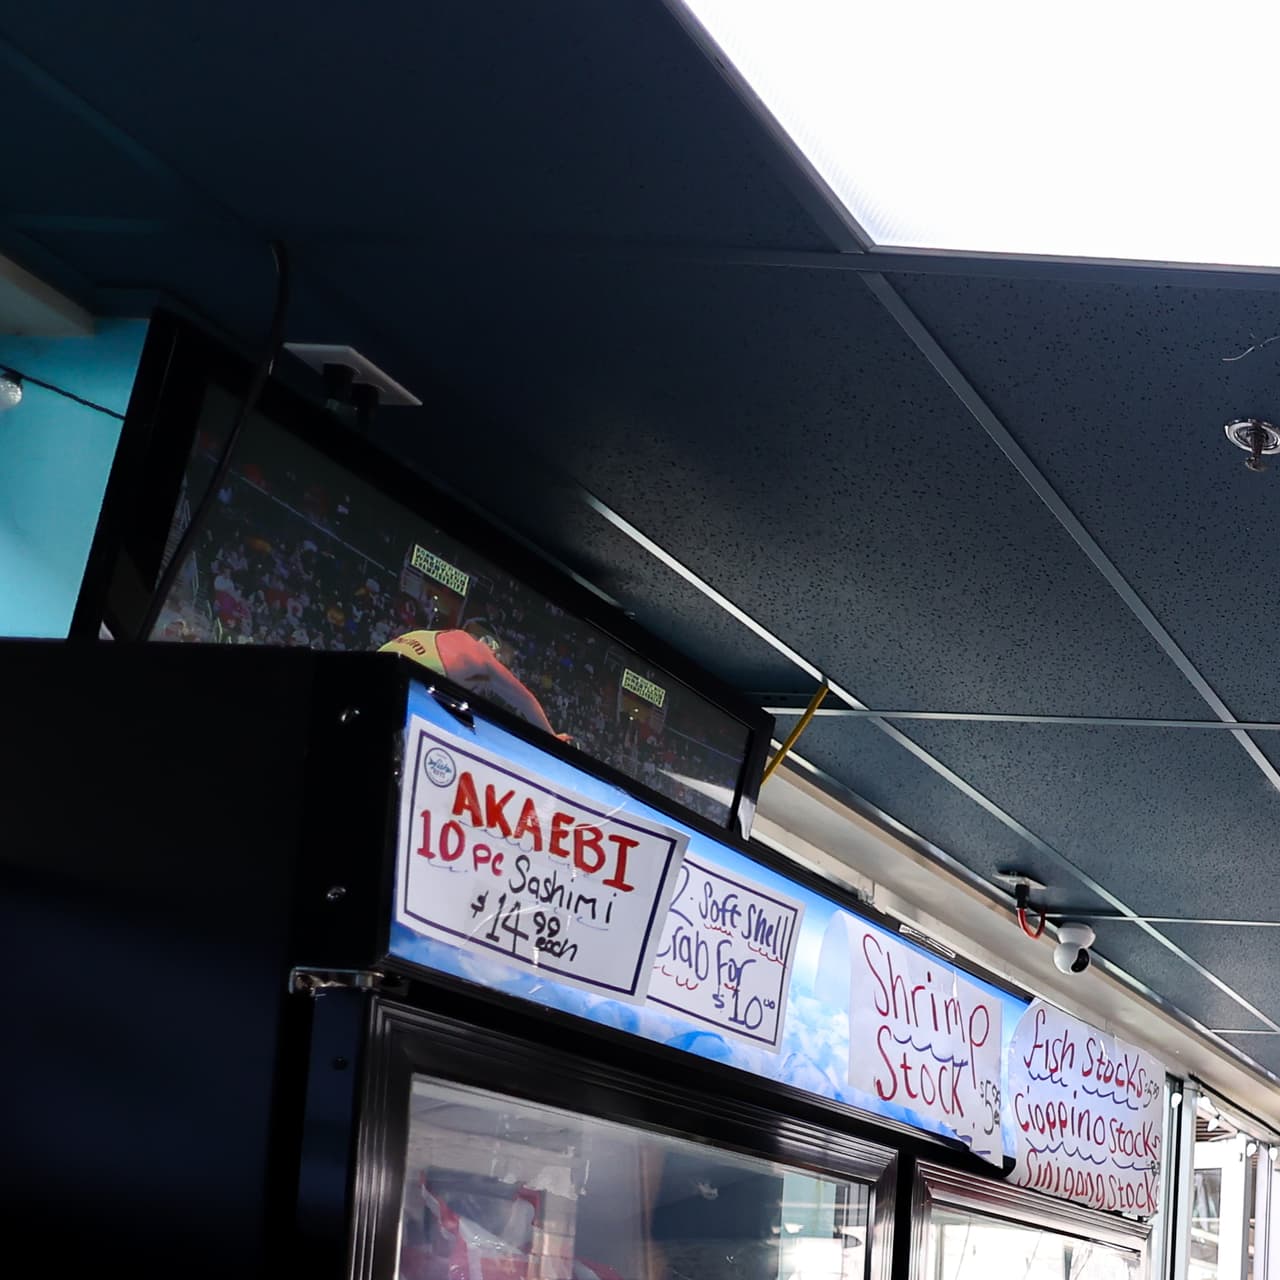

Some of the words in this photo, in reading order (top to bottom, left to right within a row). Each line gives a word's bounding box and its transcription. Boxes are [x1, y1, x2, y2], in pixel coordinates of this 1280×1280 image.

[416, 809, 465, 861] 10
[508, 854, 618, 924] Sashimi
[452, 771, 639, 893] AKAEBI
[699, 881, 742, 931] Soft
[740, 907, 788, 962] Shell
[862, 933, 990, 1090] Shrimp
[873, 1024, 966, 1118] Stock
[1081, 1036, 1147, 1099] Stocks
[1013, 1085, 1105, 1147] Cioppino
